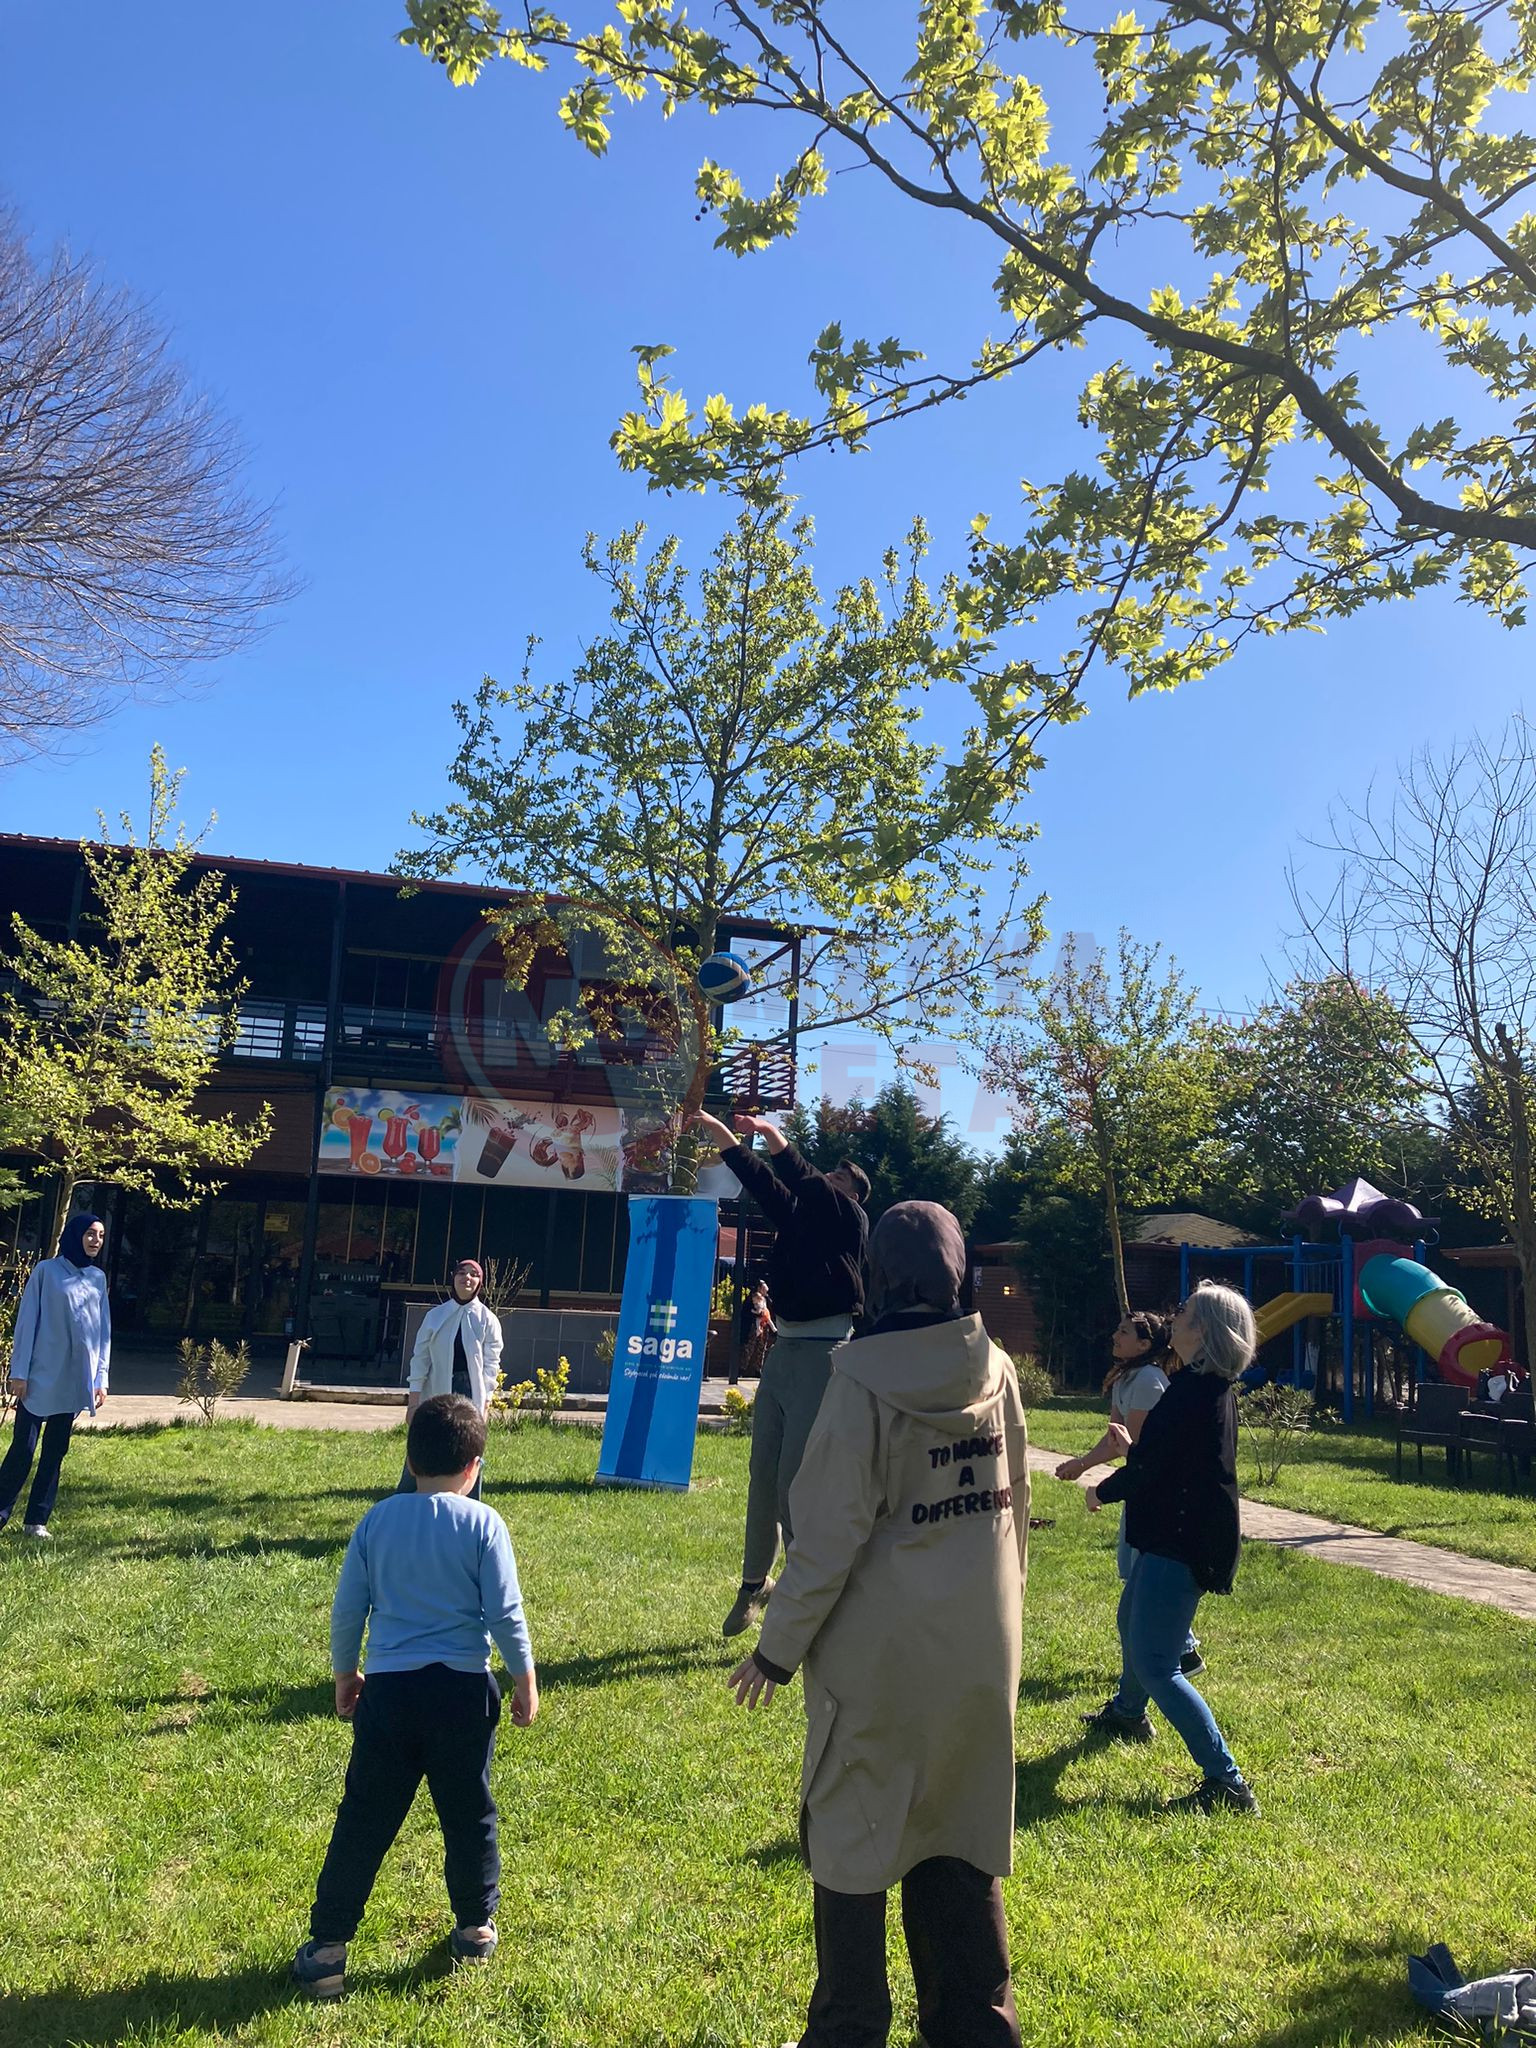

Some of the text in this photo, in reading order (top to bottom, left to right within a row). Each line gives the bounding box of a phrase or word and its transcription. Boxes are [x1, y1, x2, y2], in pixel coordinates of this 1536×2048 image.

[627, 1335, 693, 1363] saga
[928, 1433, 1003, 1469] TO MAKE
[958, 1465, 975, 1487] A
